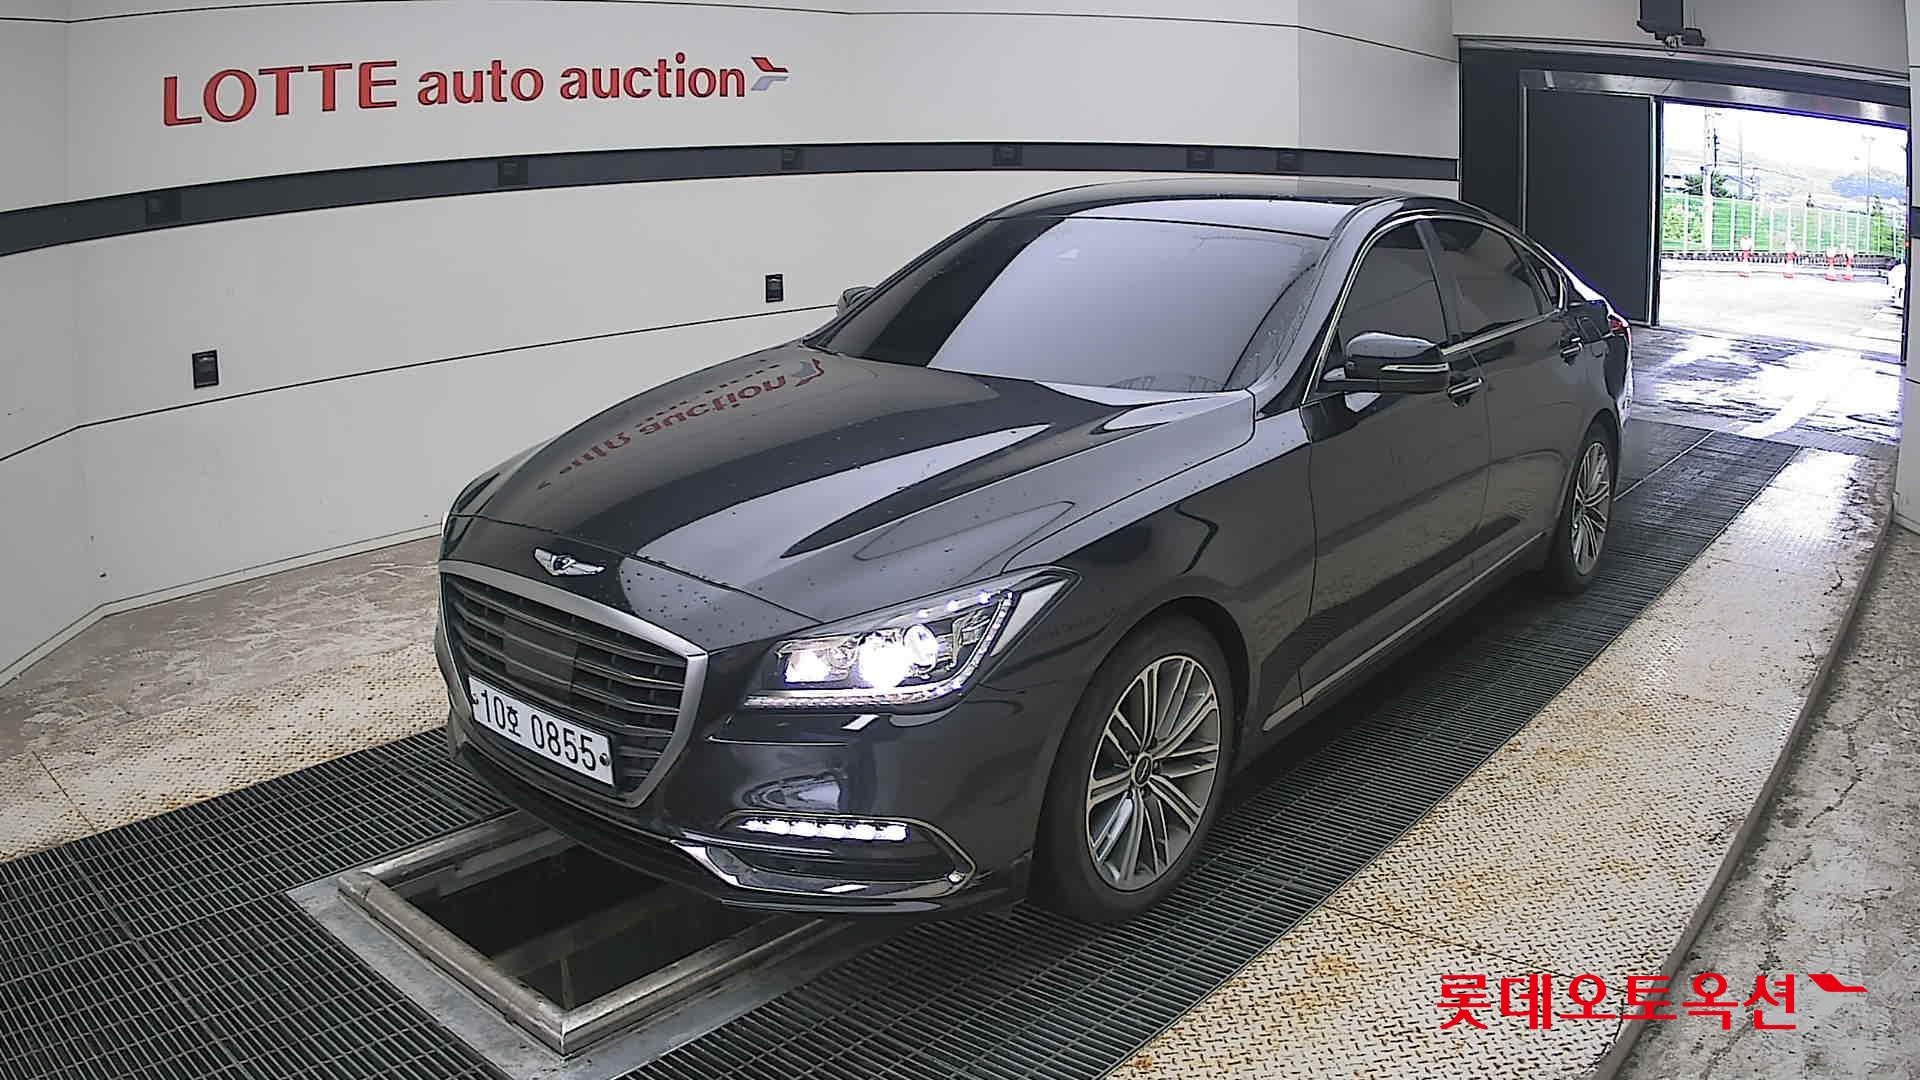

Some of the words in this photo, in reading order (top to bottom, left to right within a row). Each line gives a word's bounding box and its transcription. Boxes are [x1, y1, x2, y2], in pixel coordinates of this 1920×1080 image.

[163, 60, 398, 126] LOTTE
[417, 60, 545, 106] auto
[559, 52, 747, 100] auction
[480, 689, 522, 738] 10호
[531, 714, 597, 771] 0855
